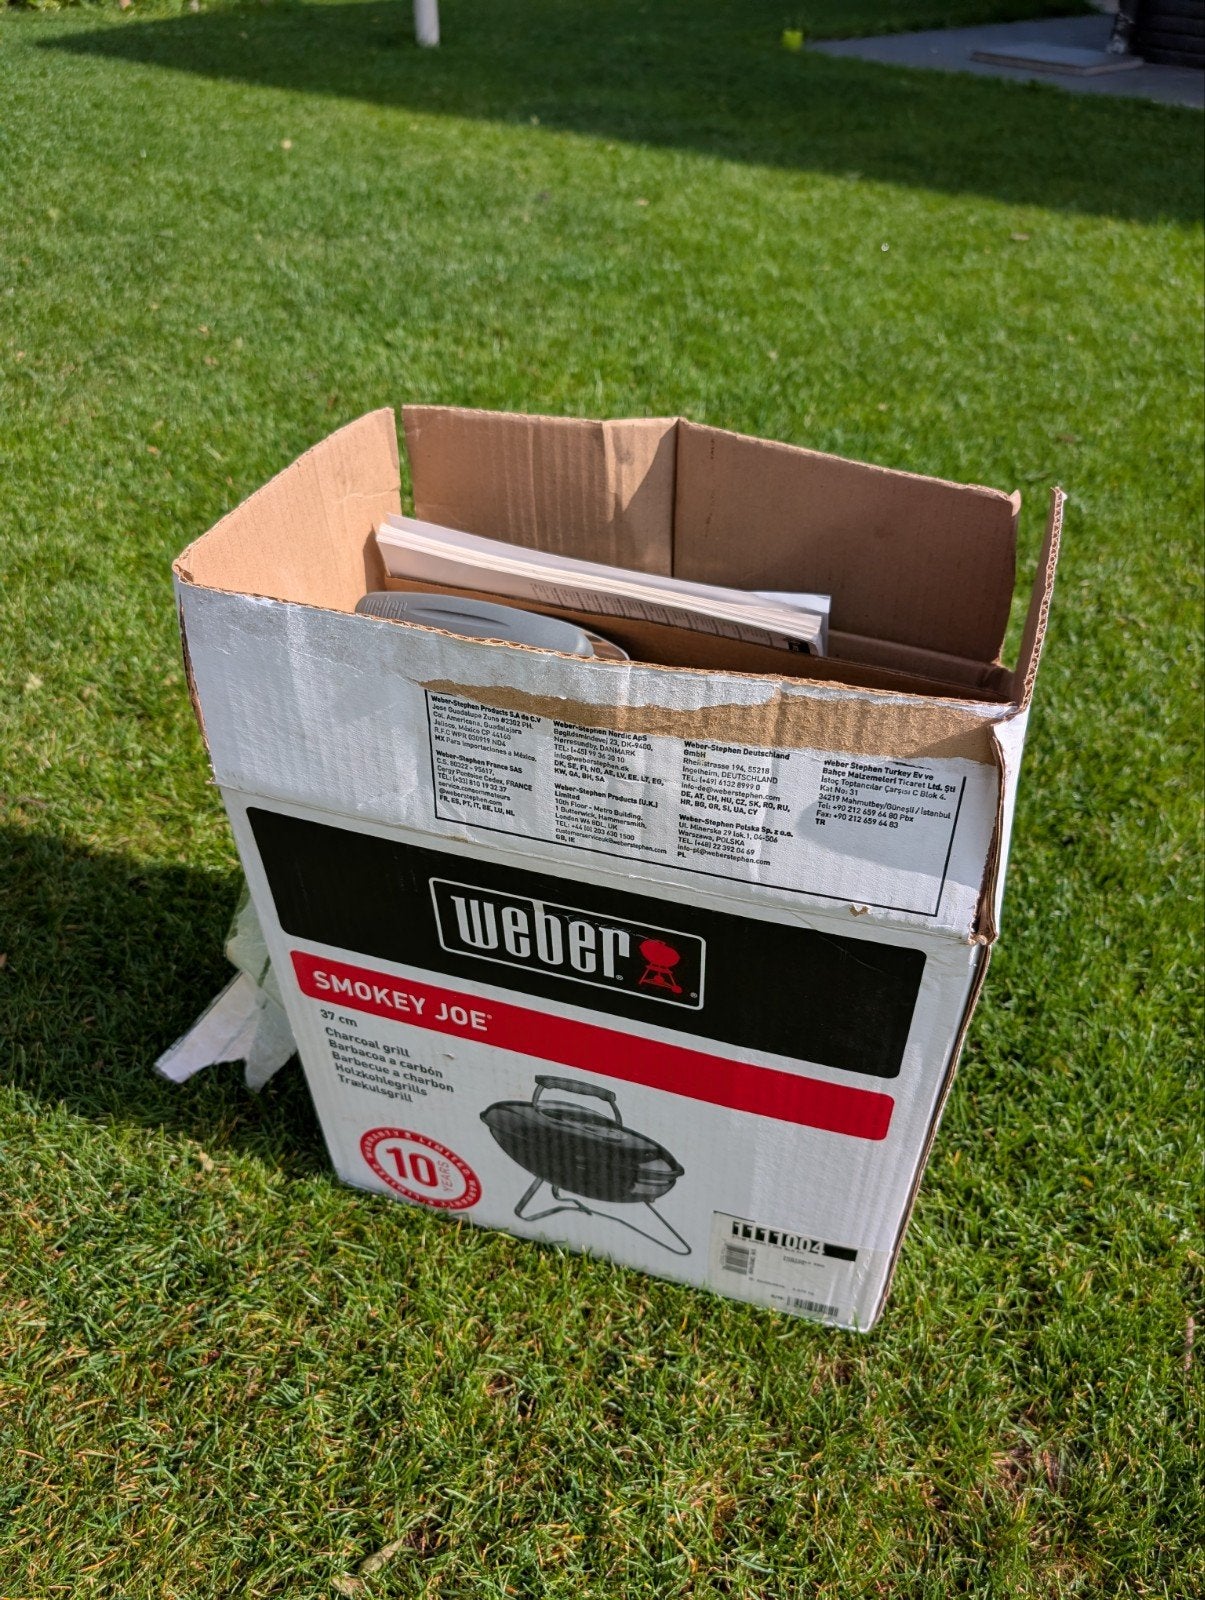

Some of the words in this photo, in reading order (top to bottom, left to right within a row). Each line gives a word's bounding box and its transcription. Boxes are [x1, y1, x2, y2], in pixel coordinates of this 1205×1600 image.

[430, 695, 479, 710] Weber-Stephen
[480, 704, 508, 716] Products
[530, 715, 541, 723] C.V
[448, 706, 482, 718] Guadalupe
[483, 721, 522, 734] Guadalajara
[553, 720, 607, 735] Weber-Stephen
[608, 729, 631, 739] Nordic
[632, 734, 647, 742] ApS
[446, 736, 461, 745] Para
[462, 741, 509, 755] importaciones
[599, 744, 635, 756] DANMARK
[609, 738, 619, 747] 23,
[684, 740, 741, 754] Weber-Stephen
[743, 748, 790, 760] Deutschland
[435, 749, 485, 765] Weber-Stephen
[486, 760, 508, 770] France
[509, 765, 522, 773] SAS
[617, 754, 625, 763] 10
[683, 749, 706, 758] GmbH
[554, 759, 566, 769] DK,
[567, 762, 578, 770] SE,
[580, 764, 589, 772] FI,
[603, 769, 615, 777] AE,
[616, 772, 626, 780] LV,
[640, 775, 650, 784] LT,
[554, 768, 567, 776] KW,
[582, 772, 594, 781] BH,
[721, 771, 778, 784] DEUTSCHLAND
[732, 764, 746, 772] 194,
[747, 766, 769, 774] 55218
[824, 759, 849, 768] Weber
[850, 762, 882, 773] Stephen
[884, 766, 911, 778] Turkey
[506, 779, 532, 791] FRANCE
[718, 779, 735, 787] 6132
[822, 767, 846, 777] Bahçe
[847, 771, 897, 784] Malzemeleri
[898, 778, 925, 788] Ticaret
[927, 783, 942, 791] Ltd.
[944, 785, 956, 793] Şti
[841, 778, 883, 791] Toptancılar
[919, 790, 937, 799] Blok
[554, 783, 606, 798] Weber-Stephen
[607, 792, 637, 804] Products
[554, 790, 580, 800] Limited
[681, 782, 780, 801] info-de@weberstephen.com
[819, 784, 833, 792] Kat
[834, 786, 847, 794] No:
[849, 788, 858, 796] 31
[462, 799, 472, 808] PT,
[494, 806, 504, 815] LU,
[570, 800, 587, 809] Floor
[593, 805, 613, 814] Metro
[680, 790, 693, 798] DE,
[694, 792, 705, 800] AT,
[706, 794, 719, 802] CH,
[721, 796, 733, 804] HU,
[735, 798, 747, 806] CZ,
[749, 800, 761, 808] SK,
[762, 801, 775, 810] RO,
[777, 804, 790, 812] RU,
[680, 798, 693, 806] HR,
[694, 800, 707, 809] BG,
[722, 804, 732, 812] SI,
[733, 806, 746, 814] UA,
[818, 793, 840, 802] 34219
[920, 807, 950, 819] İstanbul
[555, 812, 579, 822] London
[816, 809, 831, 818] Fax:
[833, 812, 846, 820] +90
[848, 814, 862, 823] 212
[817, 801, 830, 809] Tel:
[847, 805, 861, 814] 212
[862, 808, 876, 816] 659
[899, 814, 914, 822] Pbx
[598, 814, 647, 829] Hammersmith,
[678, 813, 734, 828] Weber-Stephen
[735, 823, 760, 832] Polska
[761, 826, 773, 834] Sp.
[690, 823, 721, 835] Minerska
[678, 829, 714, 842] Warszawa,
[715, 835, 745, 846] POLSKA
[677, 844, 770, 866] info-pl@weberstephen.com
[722, 844, 735, 852] 392
[450, 894, 630, 979] weber
[312, 970, 426, 1015] SMOKEY
[435, 1001, 488, 1032] JOE
[320, 1008, 335, 1021] 37
[339, 1016, 358, 1028] cm
[325, 1027, 380, 1050] Charcoal
[383, 1043, 410, 1058] grill
[328, 1039, 386, 1063] Barbacoa
[390, 1058, 396, 1066] a
[400, 1060, 443, 1079] carbón
[332, 1051, 390, 1075] Barbecue
[393, 1069, 400, 1077] a
[403, 1072, 454, 1093] charbon
[336, 1063, 428, 1097] Holzkohlegrills
[337, 1074, 413, 1103] Trækulsgrill
[386, 1147, 438, 1187] 10
[438, 1160, 455, 1192] YEARS
[733, 1221, 825, 1255] 1111004
